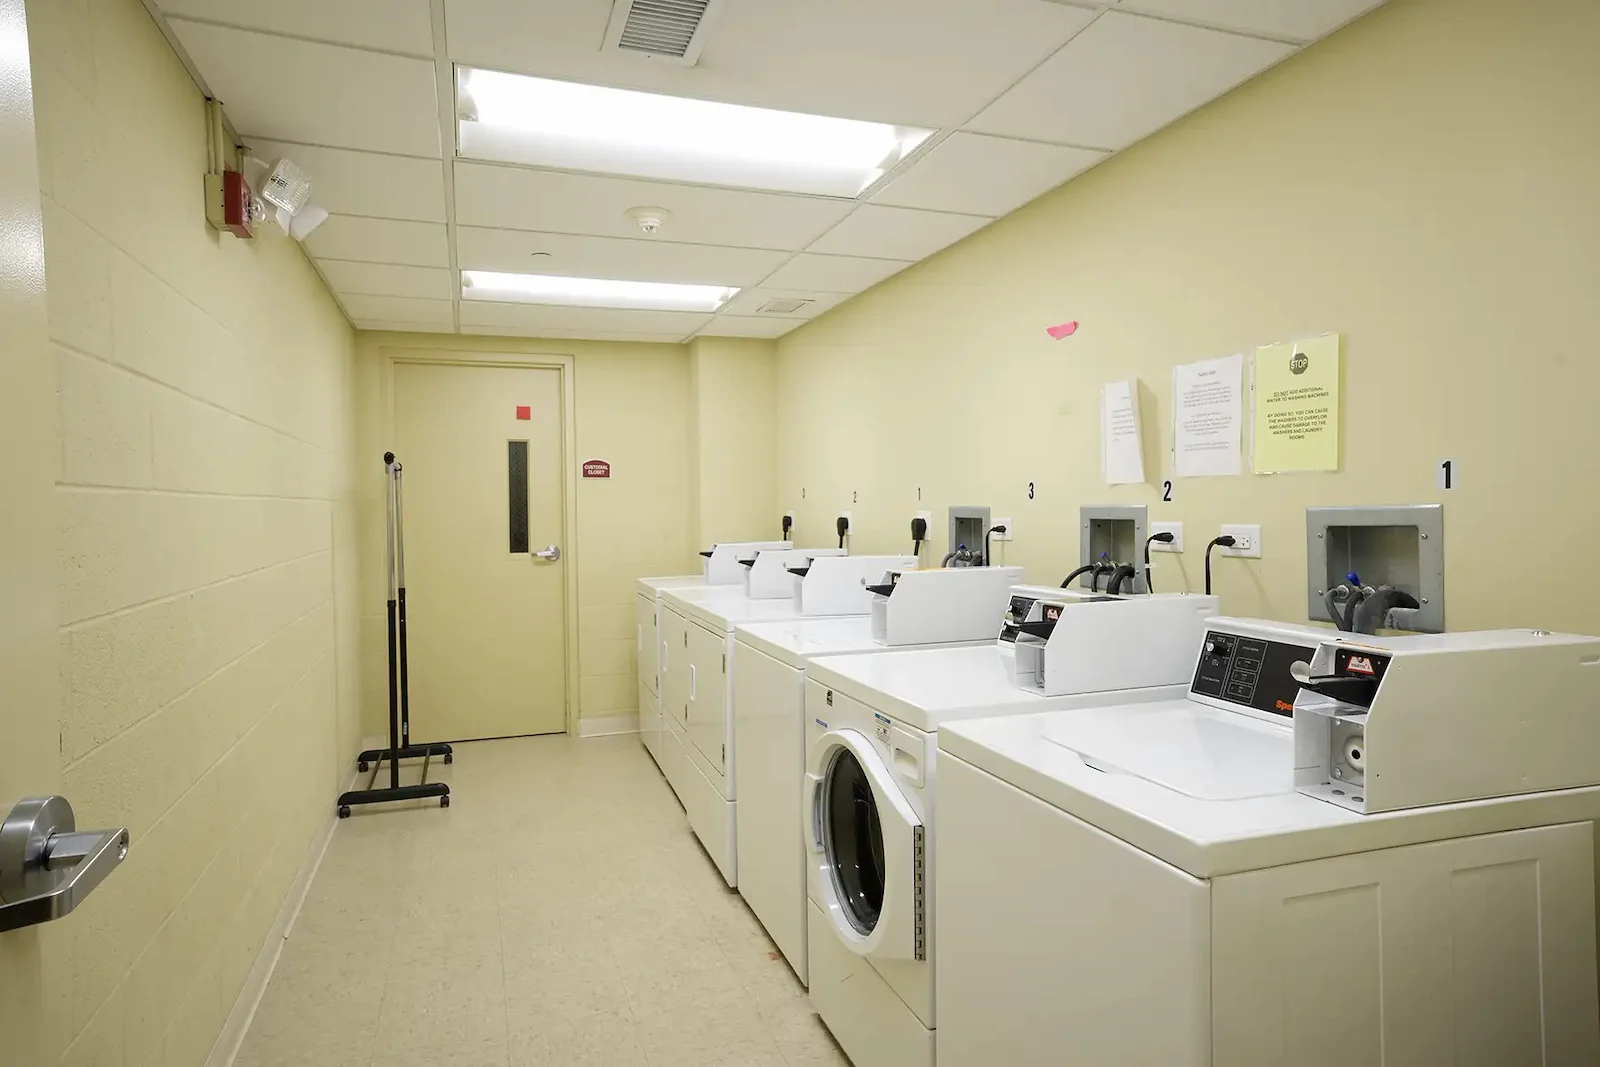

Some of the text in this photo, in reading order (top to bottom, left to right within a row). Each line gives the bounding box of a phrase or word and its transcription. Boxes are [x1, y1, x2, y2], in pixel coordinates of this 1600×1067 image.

[1290, 359, 1308, 370] STOP
[1442, 460, 1451, 489] 1
[1028, 482, 1034, 500] 3
[1163, 480, 1172, 502] 2
